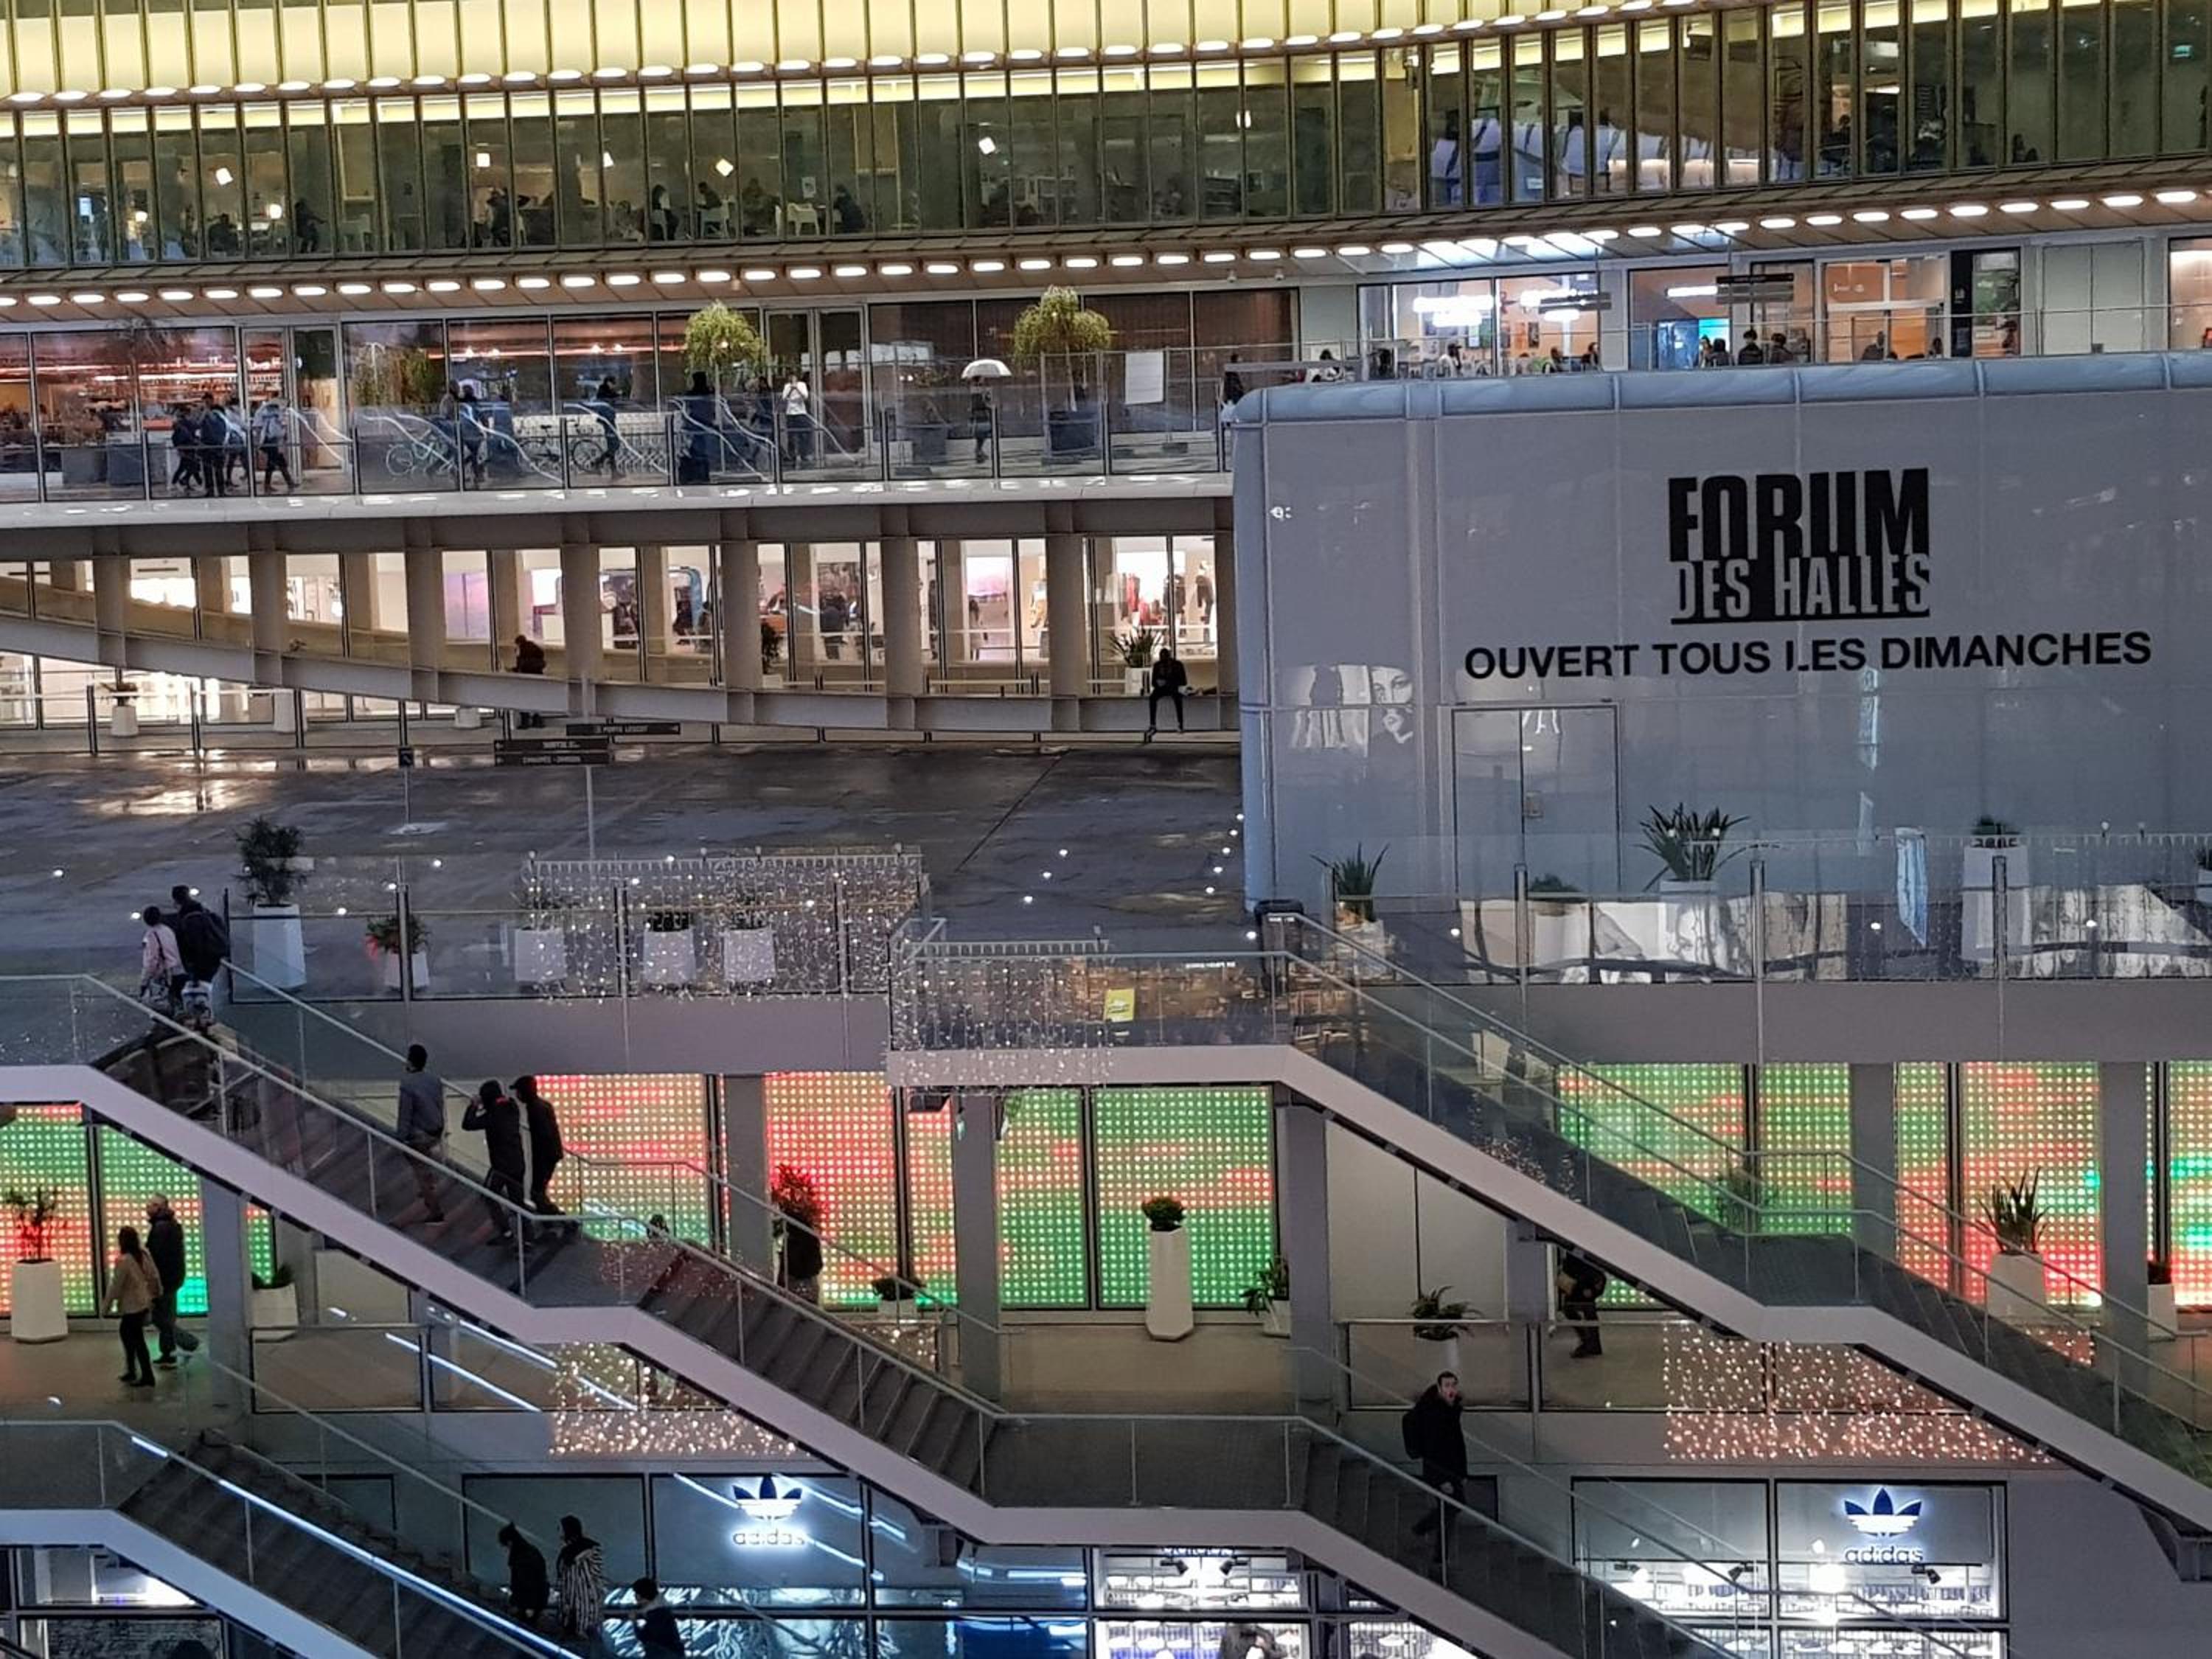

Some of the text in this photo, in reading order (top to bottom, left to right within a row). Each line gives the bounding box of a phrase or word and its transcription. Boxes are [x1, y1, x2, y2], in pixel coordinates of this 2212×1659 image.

[1668, 467, 1930, 562] FORUM
[1672, 552, 1930, 620] DES HALLES
[1464, 630, 2152, 679] OUVERT TOUS LES DIMANCHES
[1845, 1545, 1924, 1563] adidas
